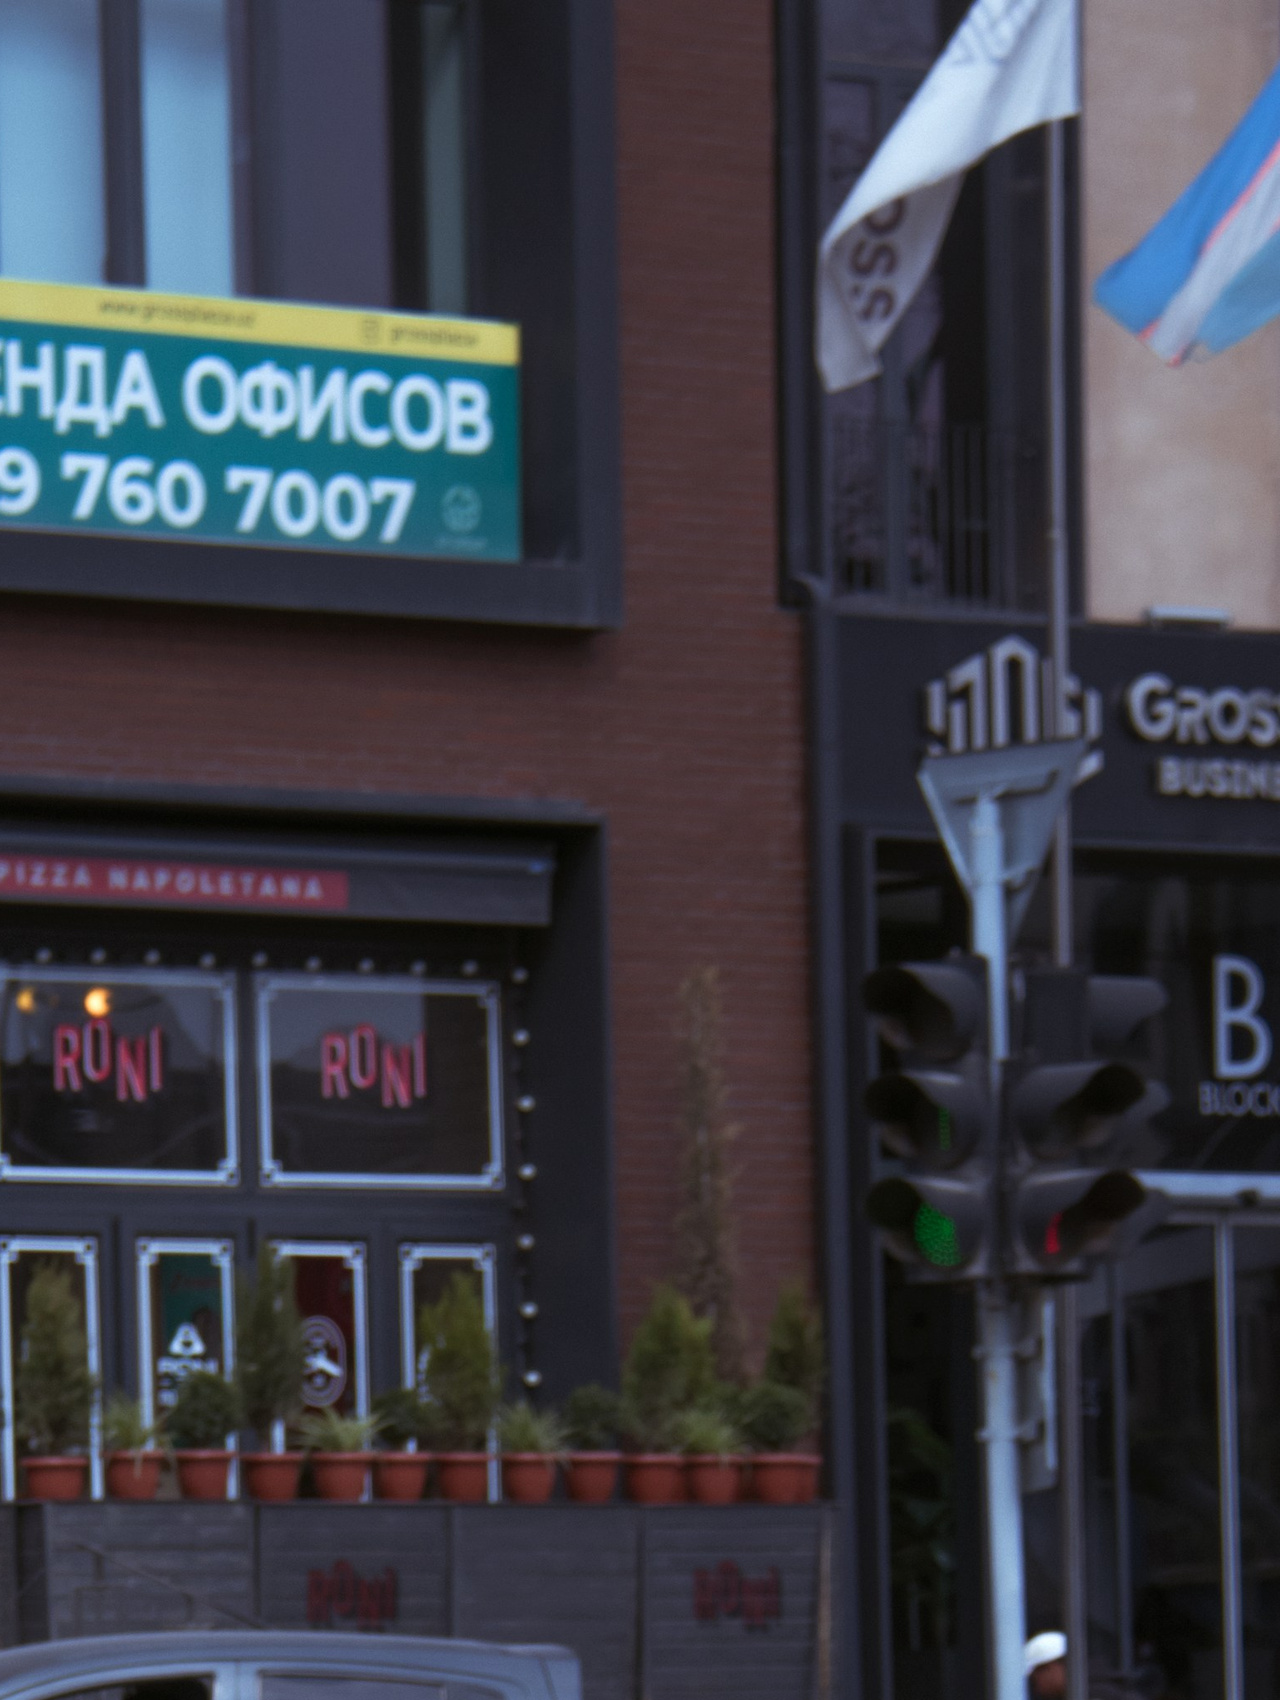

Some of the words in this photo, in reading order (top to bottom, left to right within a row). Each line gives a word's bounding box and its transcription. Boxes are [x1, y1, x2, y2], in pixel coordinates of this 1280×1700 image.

[182, 354, 494, 454] ОФИСОВ
[61, 451, 207, 530] 760
[225, 464, 416, 544] 7007
[108, 864, 323, 900] NAPOLETANA
[54, 1018, 162, 1102] RONI
[1213, 953, 1272, 1079] B
[322, 1021, 427, 1109] RONI
